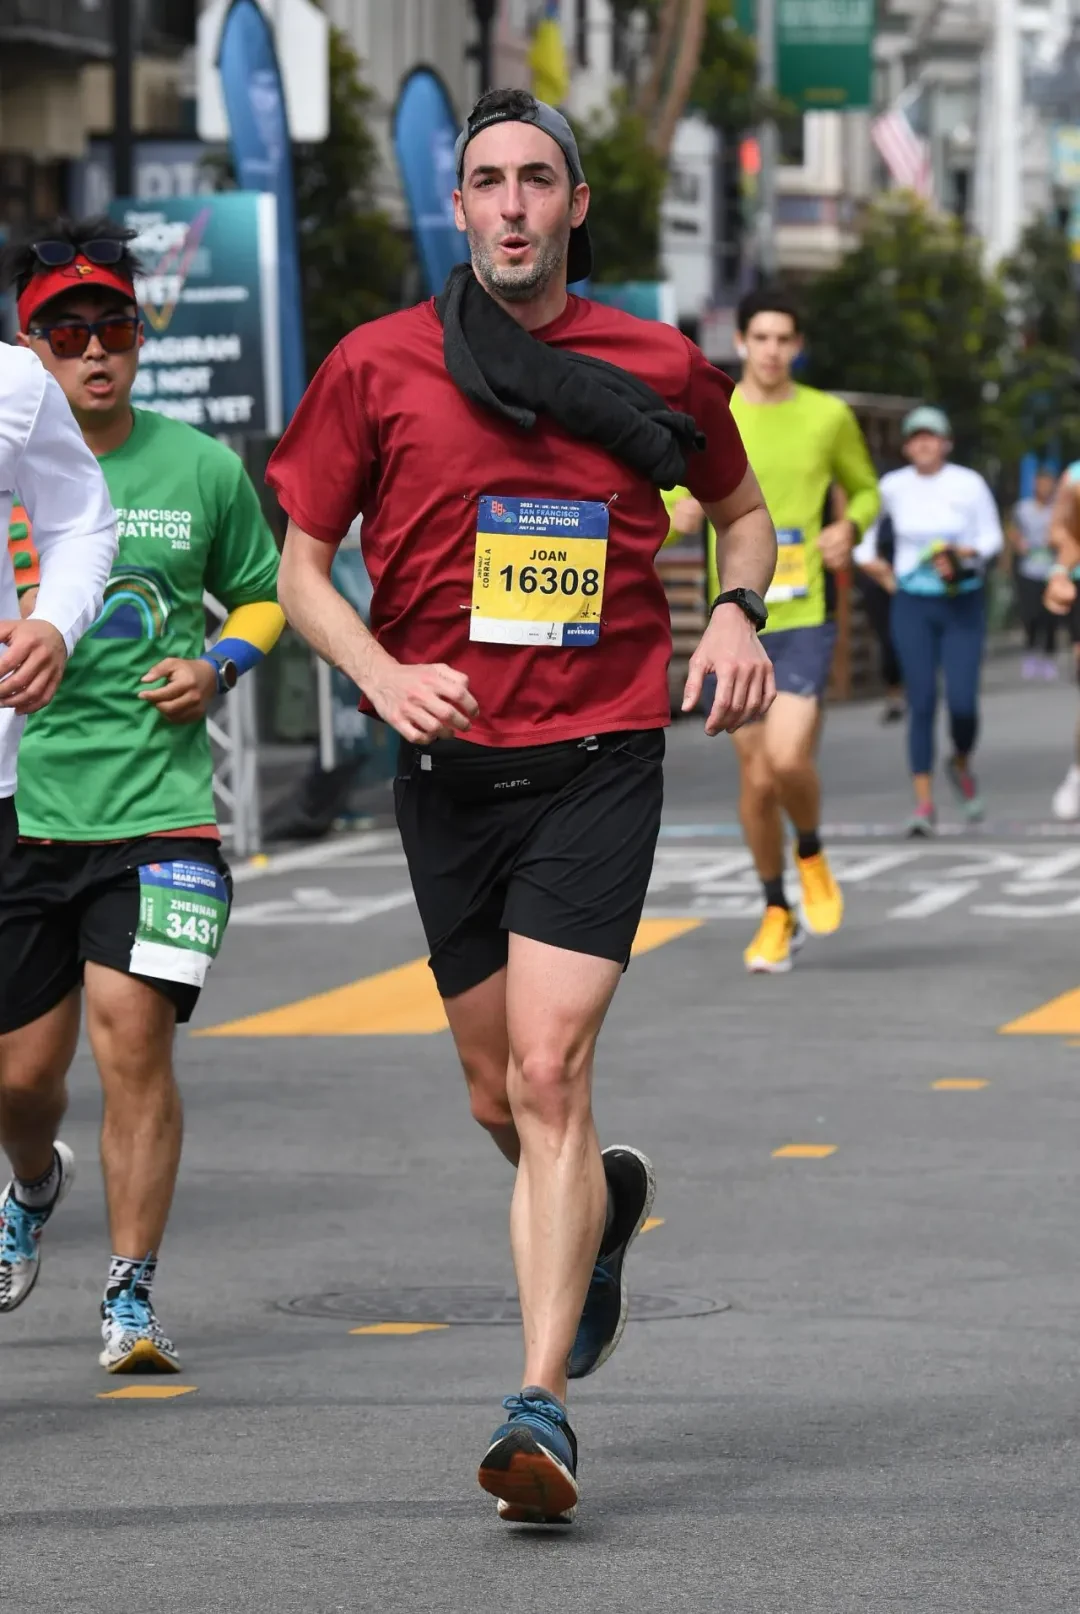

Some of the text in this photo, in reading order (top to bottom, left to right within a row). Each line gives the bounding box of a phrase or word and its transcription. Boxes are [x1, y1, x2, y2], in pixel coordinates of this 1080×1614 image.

[475, 111, 507, 127] Columbia
[205, 396, 253, 422] YET
[519, 508, 580, 518] SAN FRANCISCO
[519, 515, 579, 527] MARATHON
[529, 549, 567, 562] JOAN
[482, 557, 491, 589] CORRAL
[500, 565, 599, 596] 16308
[172, 872, 217, 888] MARATHON
[170, 899, 217, 919] ZHENNAN
[166, 912, 219, 949] 3431
